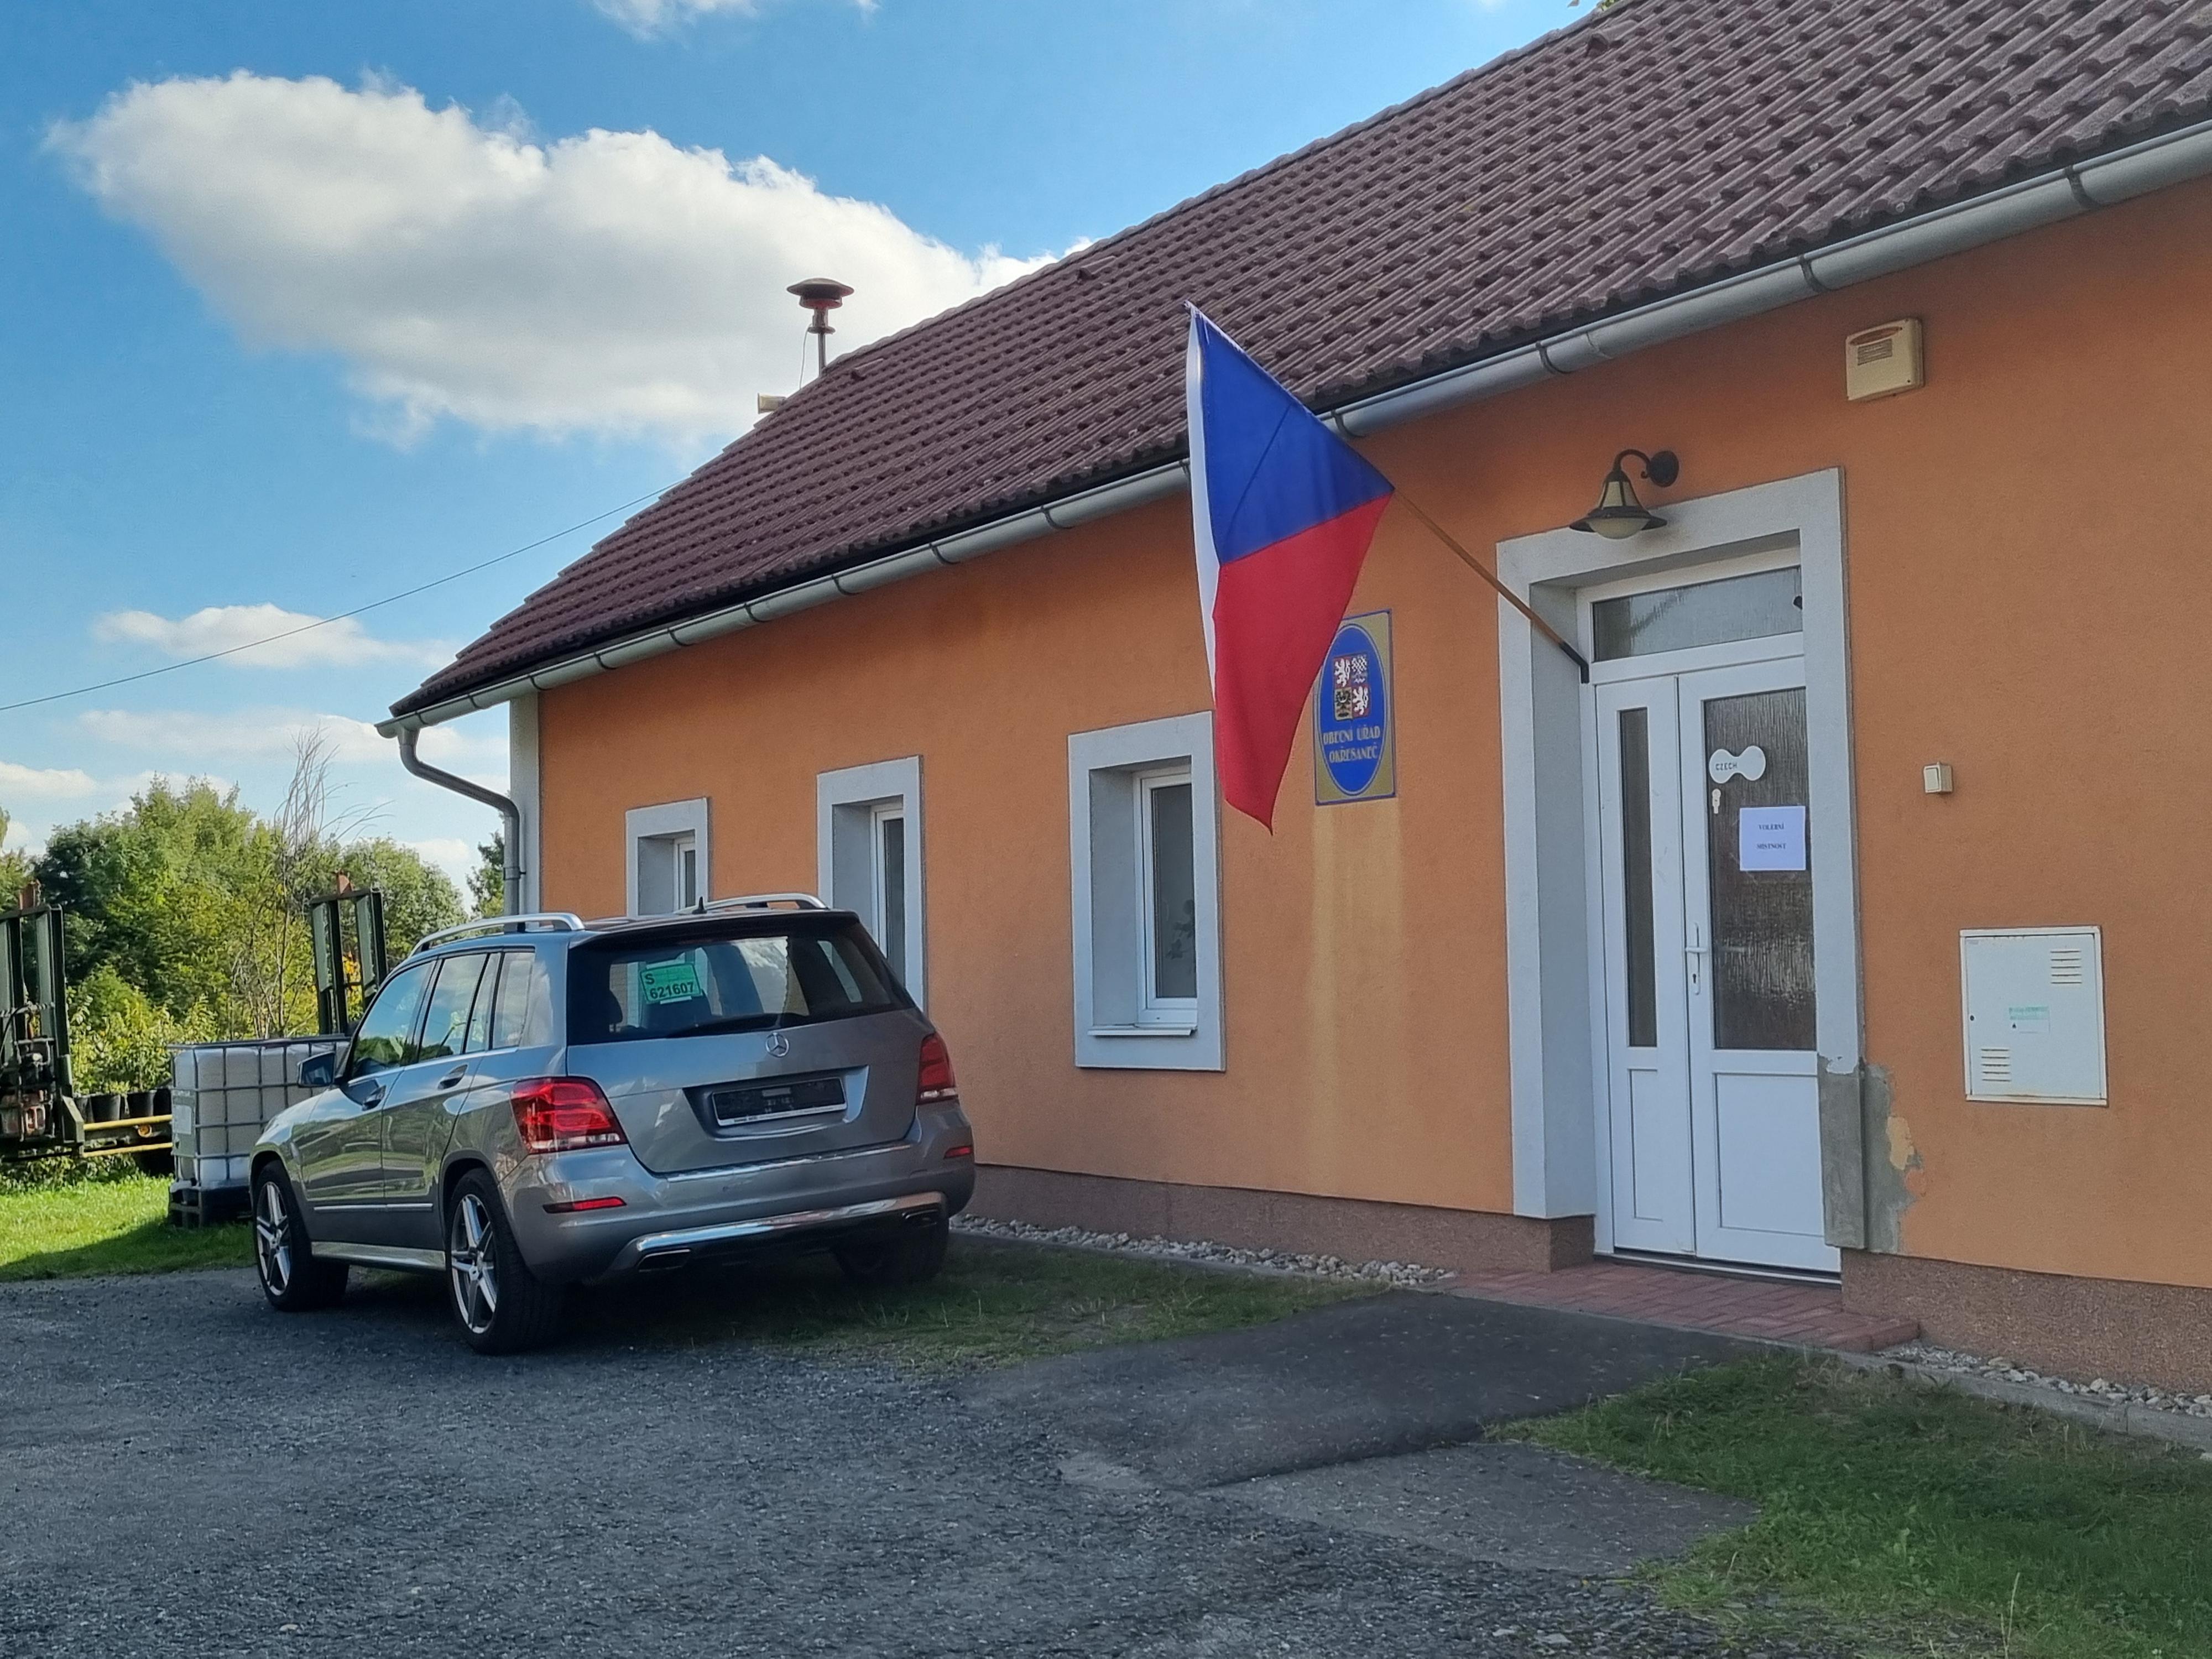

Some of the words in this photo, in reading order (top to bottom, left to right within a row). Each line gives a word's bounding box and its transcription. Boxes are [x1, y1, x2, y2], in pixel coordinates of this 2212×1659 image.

[1323, 726, 1353, 745] OBECNÍ
[1329, 742, 1377, 763] OKŘESANEČ
[1716, 762, 1738, 770] CZECH
[645, 973, 655, 984] S
[650, 982, 693, 999] 621607
